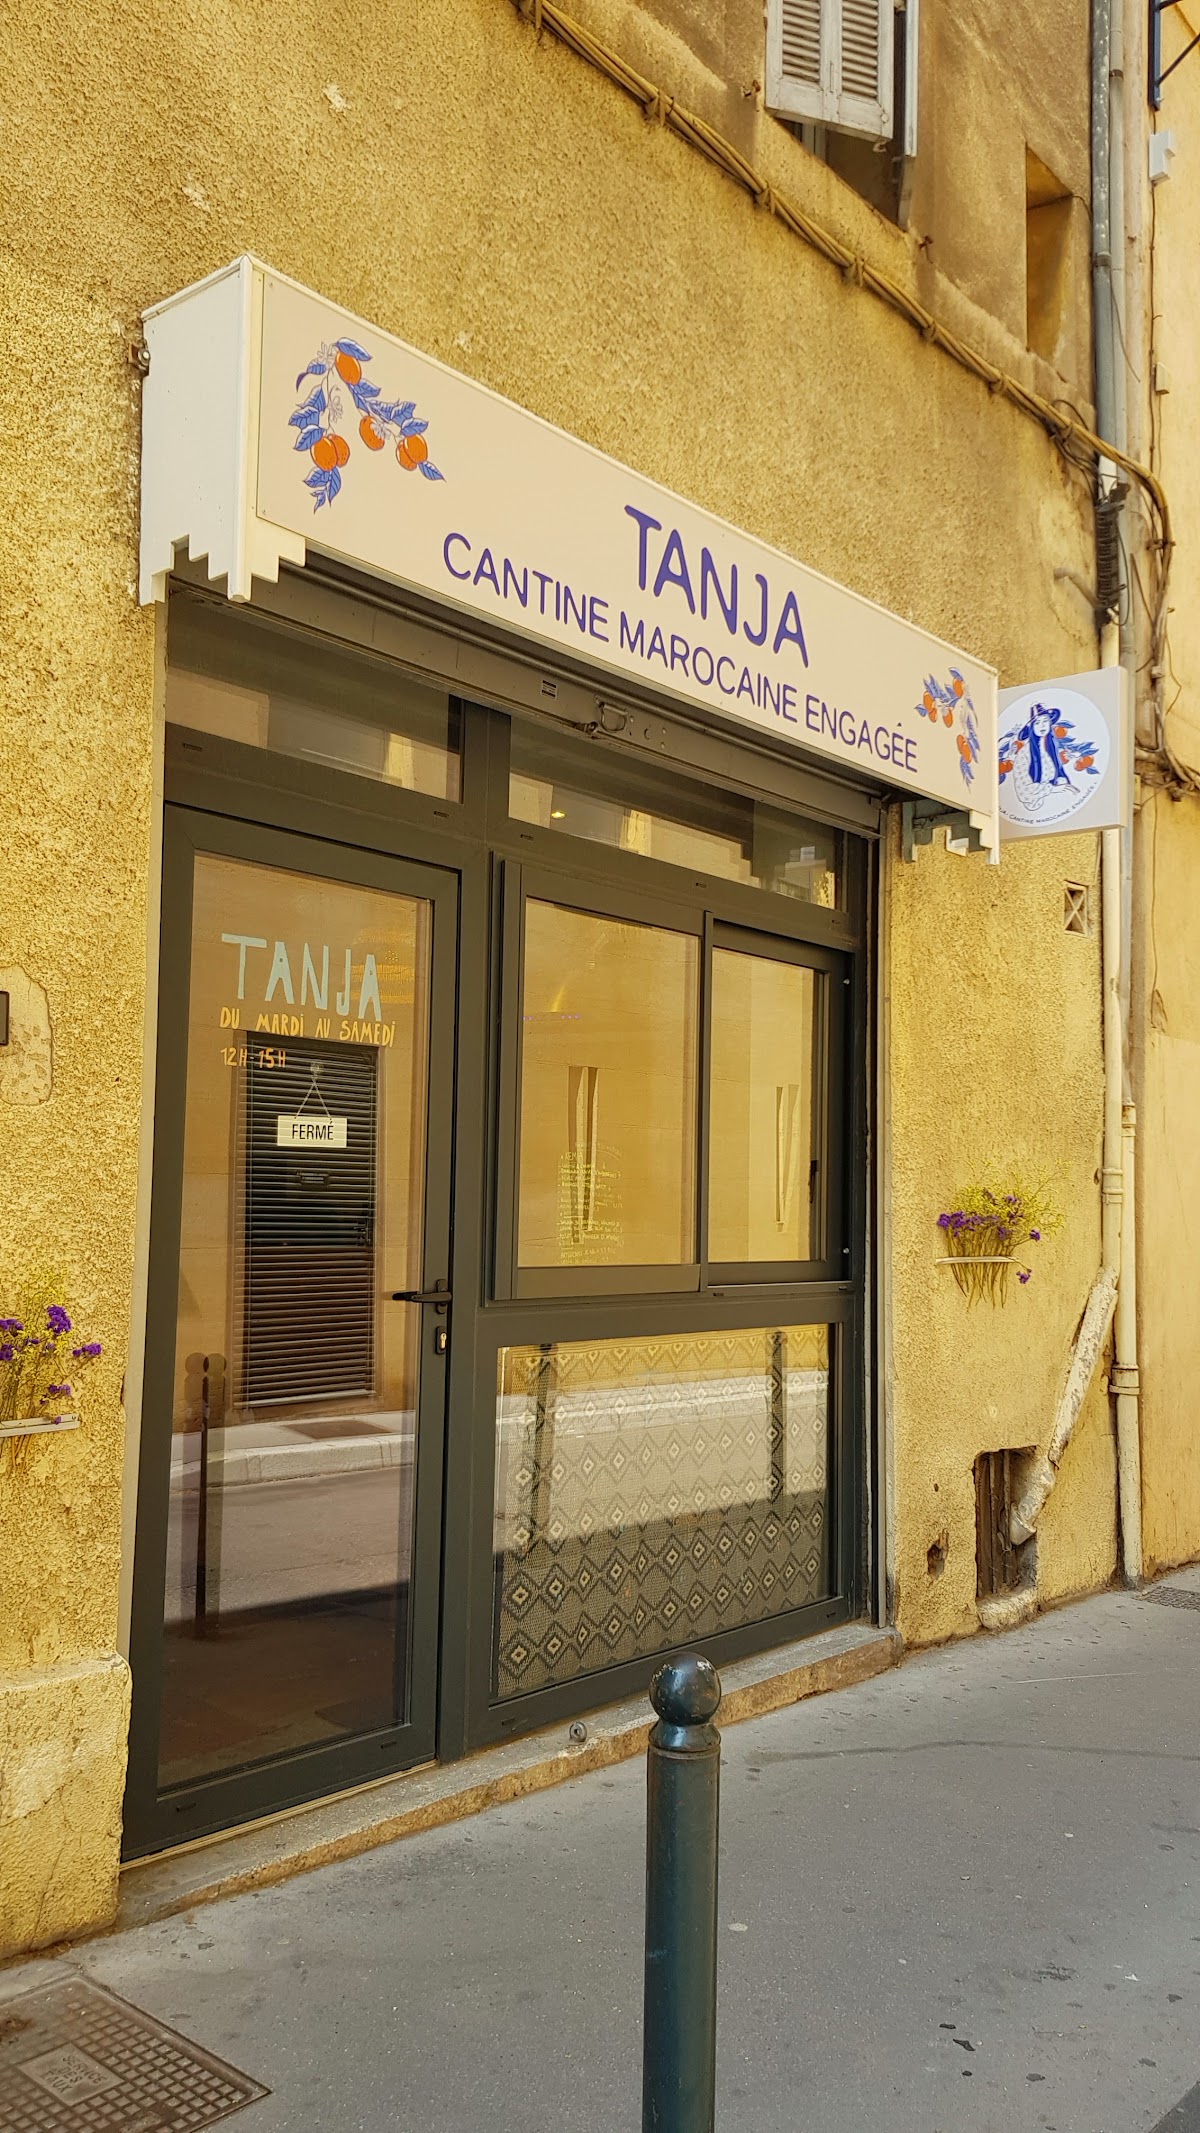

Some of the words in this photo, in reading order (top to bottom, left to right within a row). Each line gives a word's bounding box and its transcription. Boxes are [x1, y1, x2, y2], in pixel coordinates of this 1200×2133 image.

[623, 504, 809, 669] TANJA
[443, 531, 610, 643] CANTINE
[620, 610, 798, 723] MAROCAINE
[805, 693, 918, 773] ENGAGÉE
[1009, 814, 1034, 824] CANTINE
[221, 932, 382, 1022] TANJA
[219, 1006, 240, 1030] DU
[315, 1018, 331, 1039] AU
[292, 1121, 334, 1141] FERMÉ
[41, 2070, 73, 2093] EAUX
[58, 2066, 83, 2084] DES
[62, 2055, 107, 2084] SERVICE
